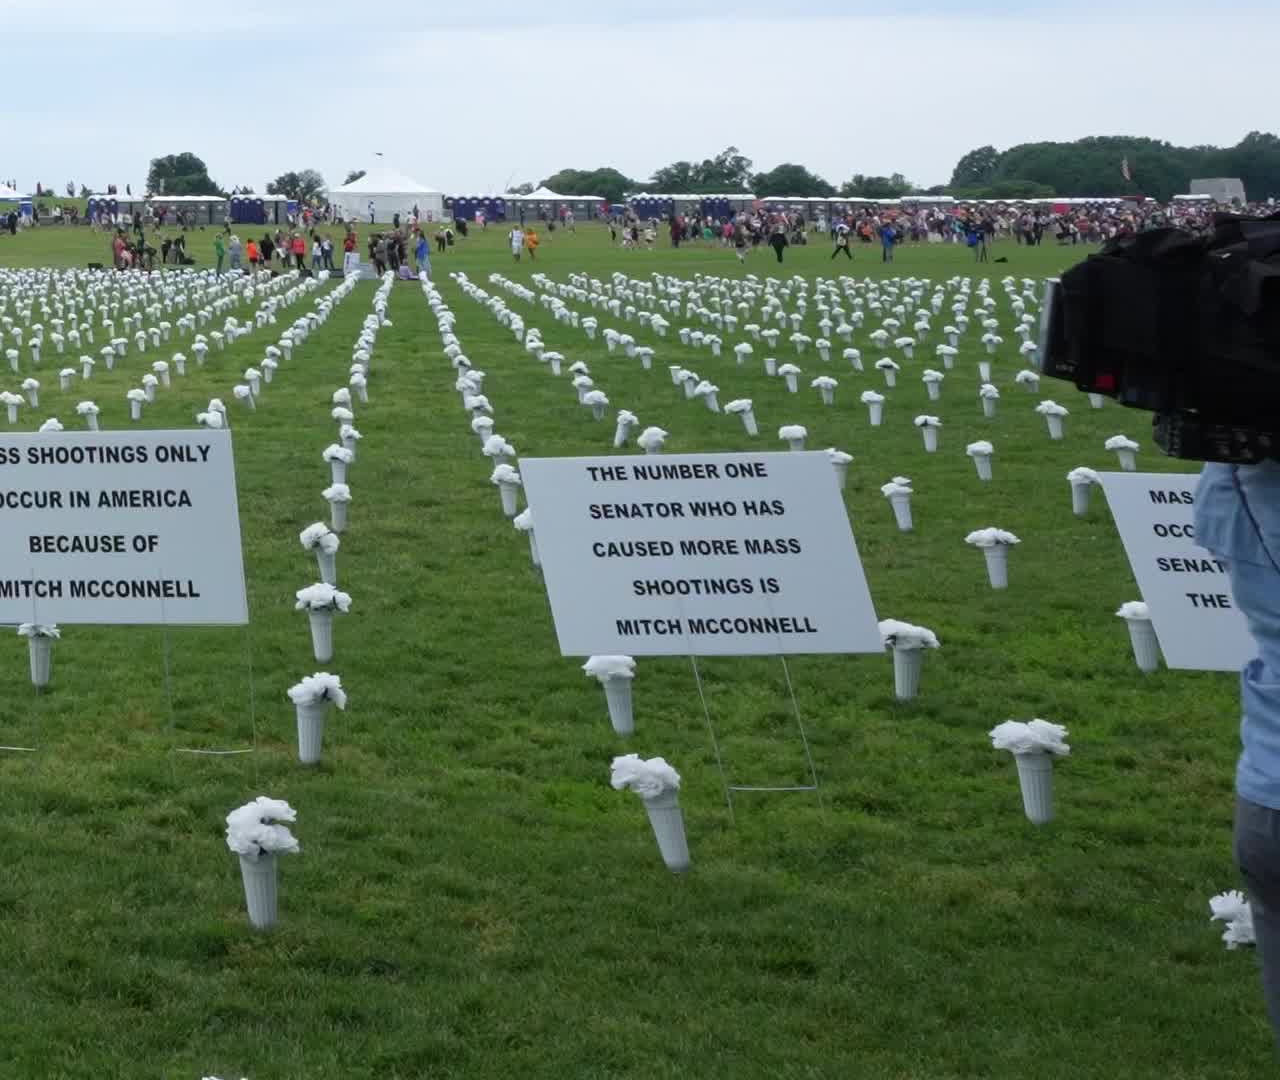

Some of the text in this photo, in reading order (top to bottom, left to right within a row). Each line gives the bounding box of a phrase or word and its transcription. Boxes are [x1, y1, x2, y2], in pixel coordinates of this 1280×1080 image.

[28, 446, 148, 464] SHOOTINGS
[156, 445, 210, 462] ONLY
[587, 463, 767, 481] THE NUMBER ONE
[70, 491, 90, 507] IN
[98, 490, 191, 507] AMERICA
[1149, 490, 1194, 504] MAS
[590, 500, 784, 519] SENATOR WHO HAS
[1154, 524, 1194, 538] OCC
[30, 535, 158, 552] BECAUSE OF
[593, 539, 801, 557] CAUSED MORE MASS
[1156, 558, 1225, 573] SENAT
[70, 580, 200, 597] MCCONNELL
[633, 578, 779, 595] SHOOTINGS IS
[1186, 593, 1231, 608] THE
[616, 618, 817, 635] MITCH MCCONNELL
